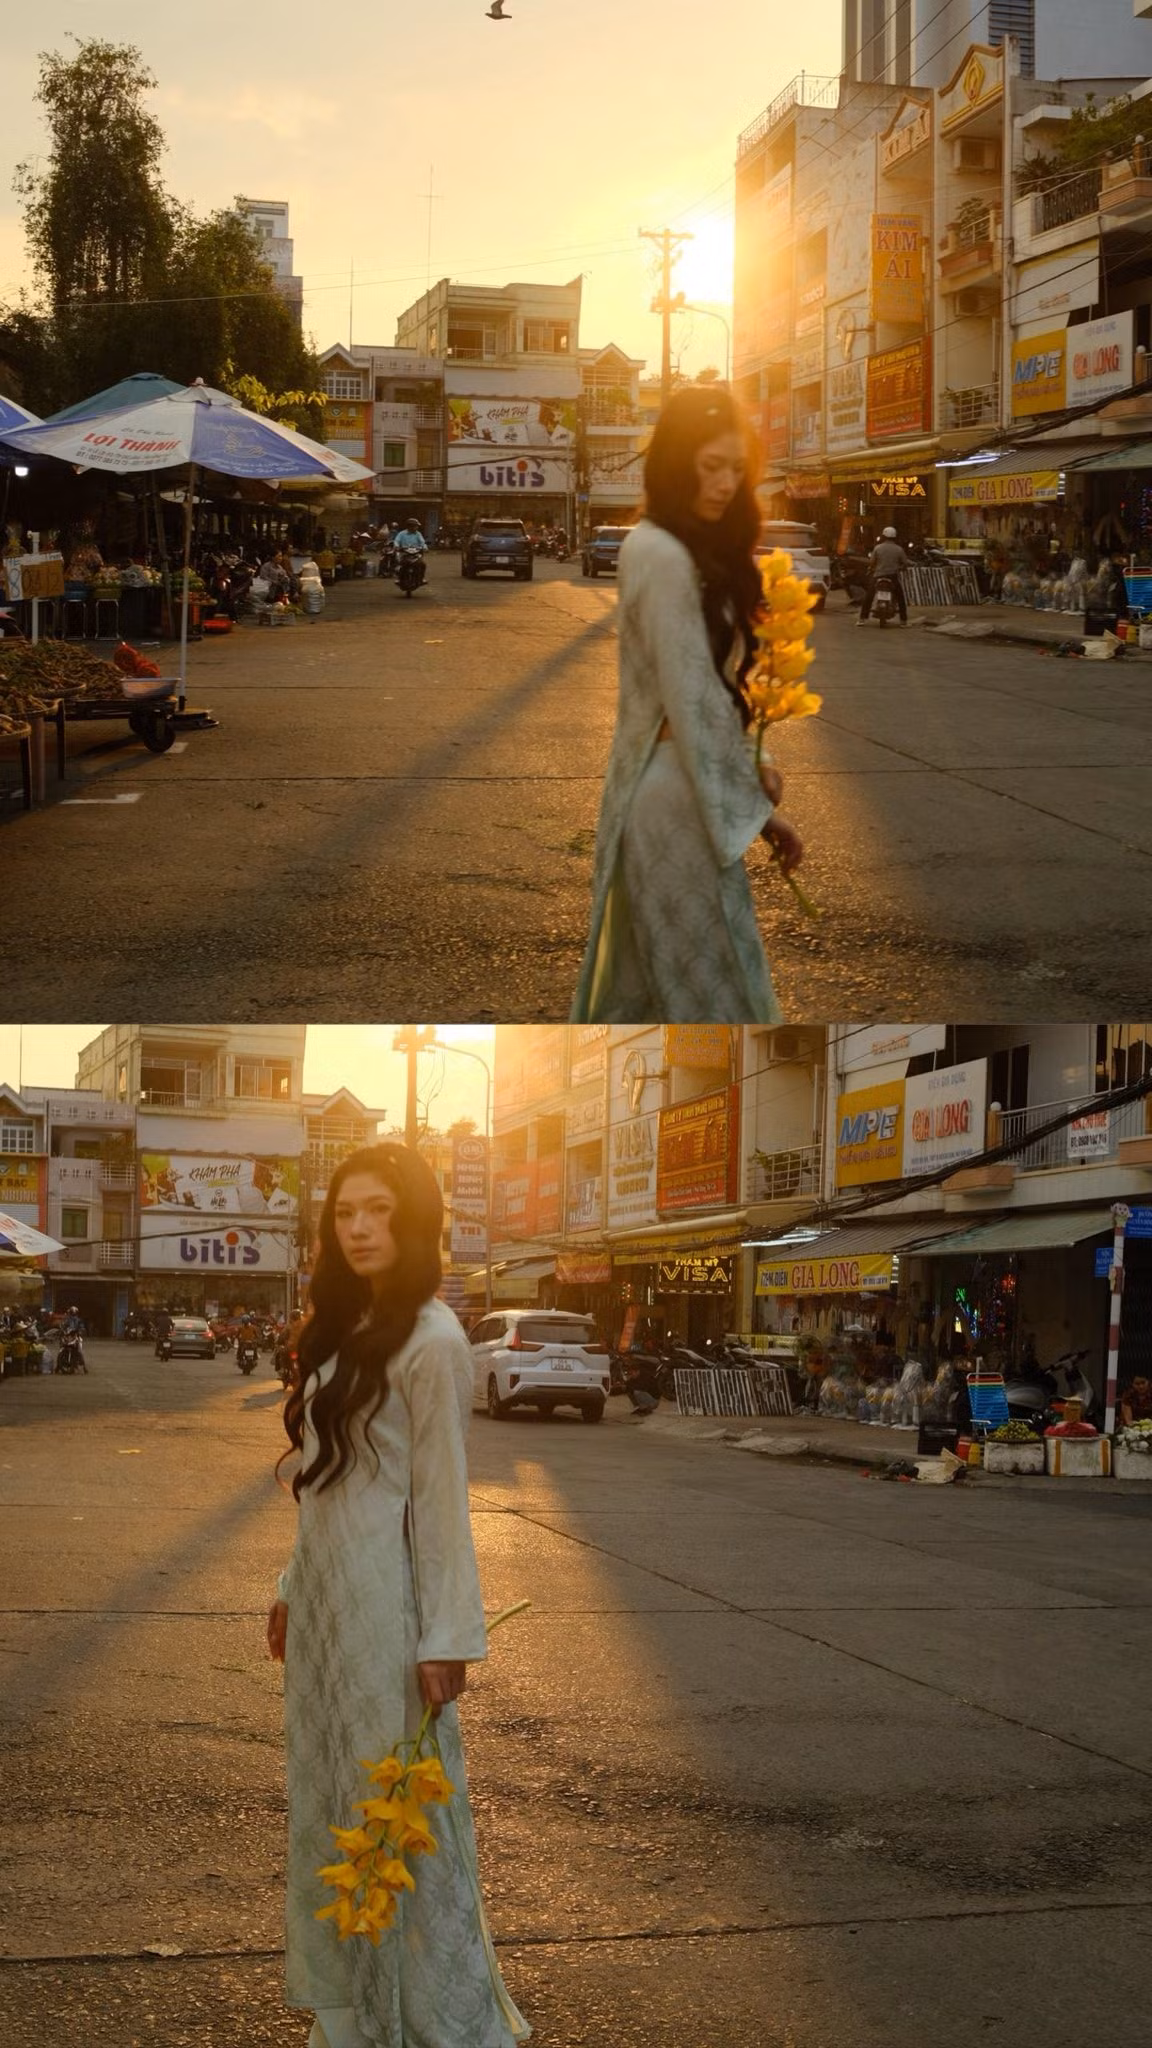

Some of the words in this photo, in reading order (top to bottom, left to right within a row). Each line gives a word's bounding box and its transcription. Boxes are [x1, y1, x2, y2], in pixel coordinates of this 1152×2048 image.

[876, 231, 918, 251] KIM
[884, 251, 911, 279] ÁI
[1014, 348, 1062, 384] MPE
[1092, 344, 1120, 376] LONG
[83, 432, 117, 447] LỢI
[120, 439, 181, 452] THÀNH
[872, 483, 926, 496] VISA
[977, 481, 996, 500] GIA
[1001, 477, 1033, 499] LONG
[839, 1104, 899, 1148] MPE
[936, 1099, 971, 1137] LONG
[189, 1164, 217, 1181] KHÁM
[218, 1161, 241, 1178] PHÁ
[663, 1266, 728, 1282] VISA
[791, 1265, 815, 1289] GIA
[819, 1261, 860, 1287] LONG
